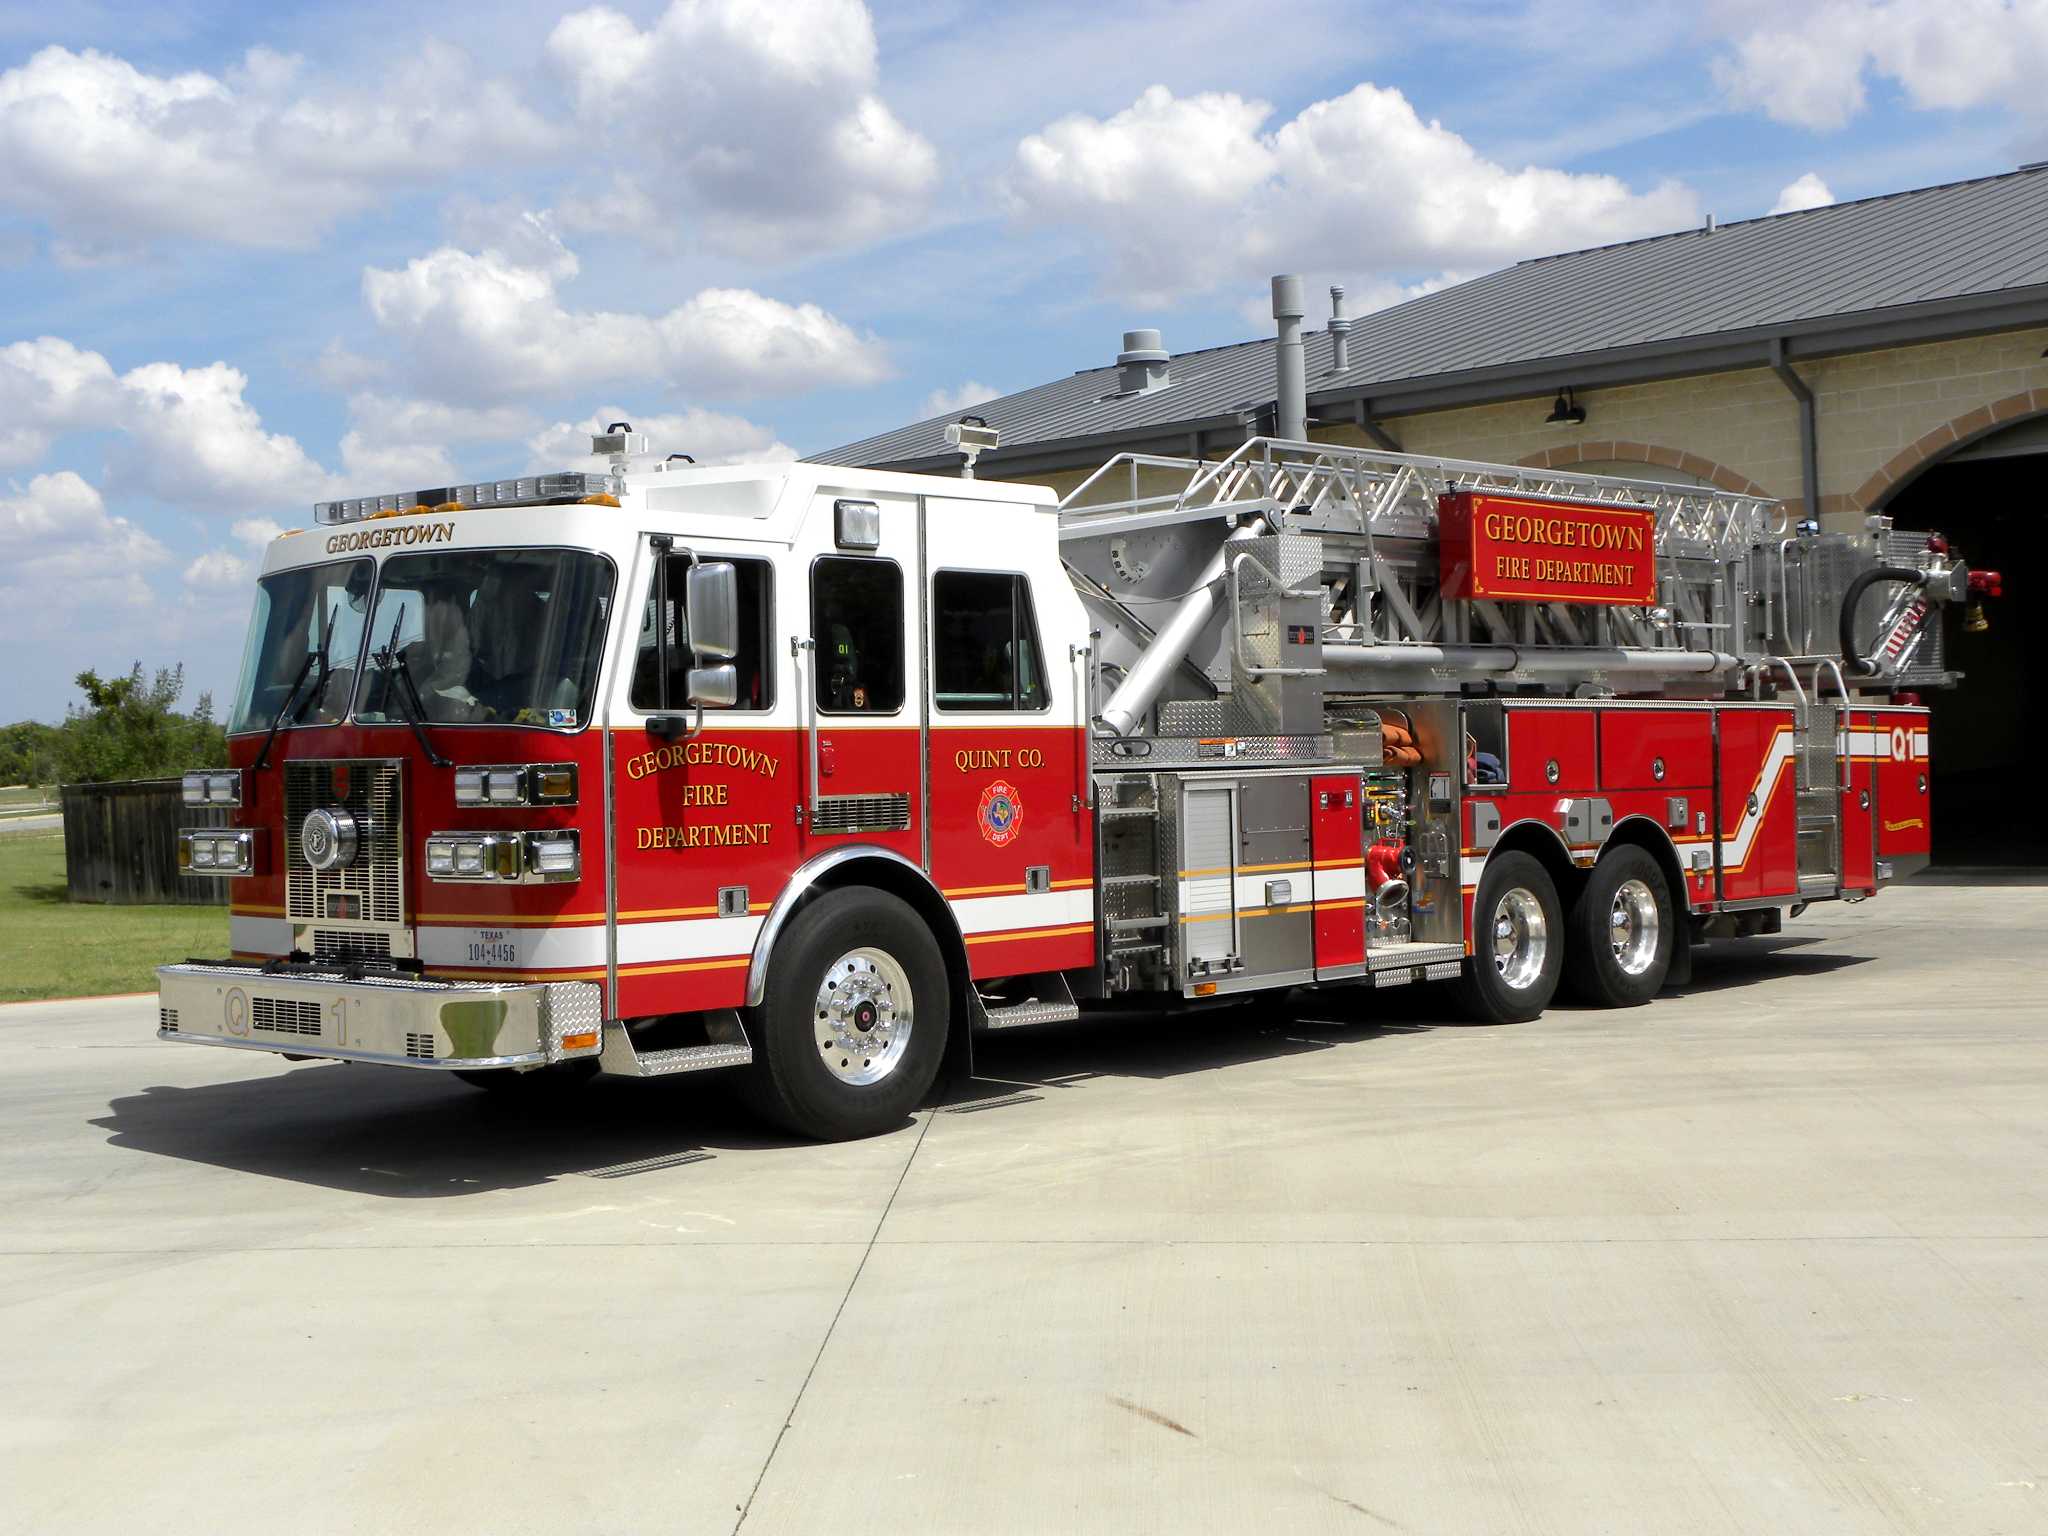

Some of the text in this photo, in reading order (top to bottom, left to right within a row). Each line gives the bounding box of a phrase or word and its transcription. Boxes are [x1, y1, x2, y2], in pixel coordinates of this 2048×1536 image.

[326, 522, 456, 554] GEORGETOWN
[1484, 513, 1645, 551] GEORGETOWN
[1496, 555, 1635, 586] FIRE DEPARTMENT
[1891, 726, 1915, 762] Q1
[627, 743, 779, 780] GEORGETOWN
[955, 748, 1045, 773] QUINT CO.
[683, 784, 729, 807] FIRE
[992, 786, 1008, 794] FIRE
[637, 823, 772, 850] DEPARTMENT
[992, 832, 1009, 842] DEPT
[480, 931, 503, 940] TEXAS
[224, 986, 347, 1047] Q 1
